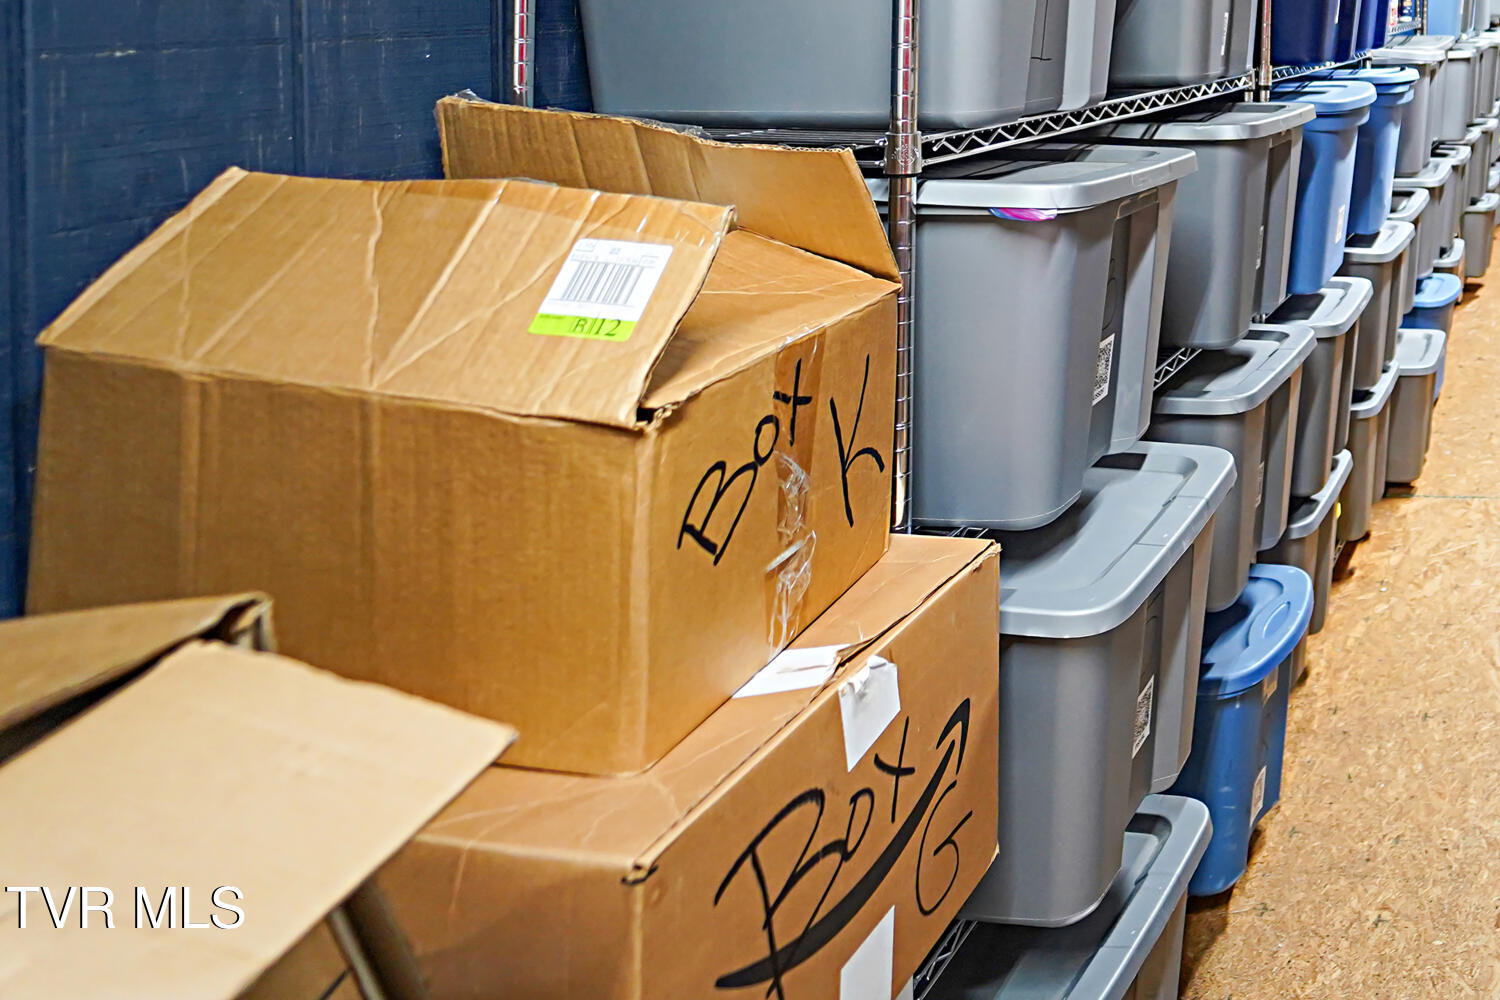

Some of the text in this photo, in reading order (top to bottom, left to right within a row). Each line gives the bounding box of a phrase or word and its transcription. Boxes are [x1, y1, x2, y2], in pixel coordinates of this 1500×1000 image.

[678, 354, 886, 566] Box K
[714, 716, 974, 1000] Box G
